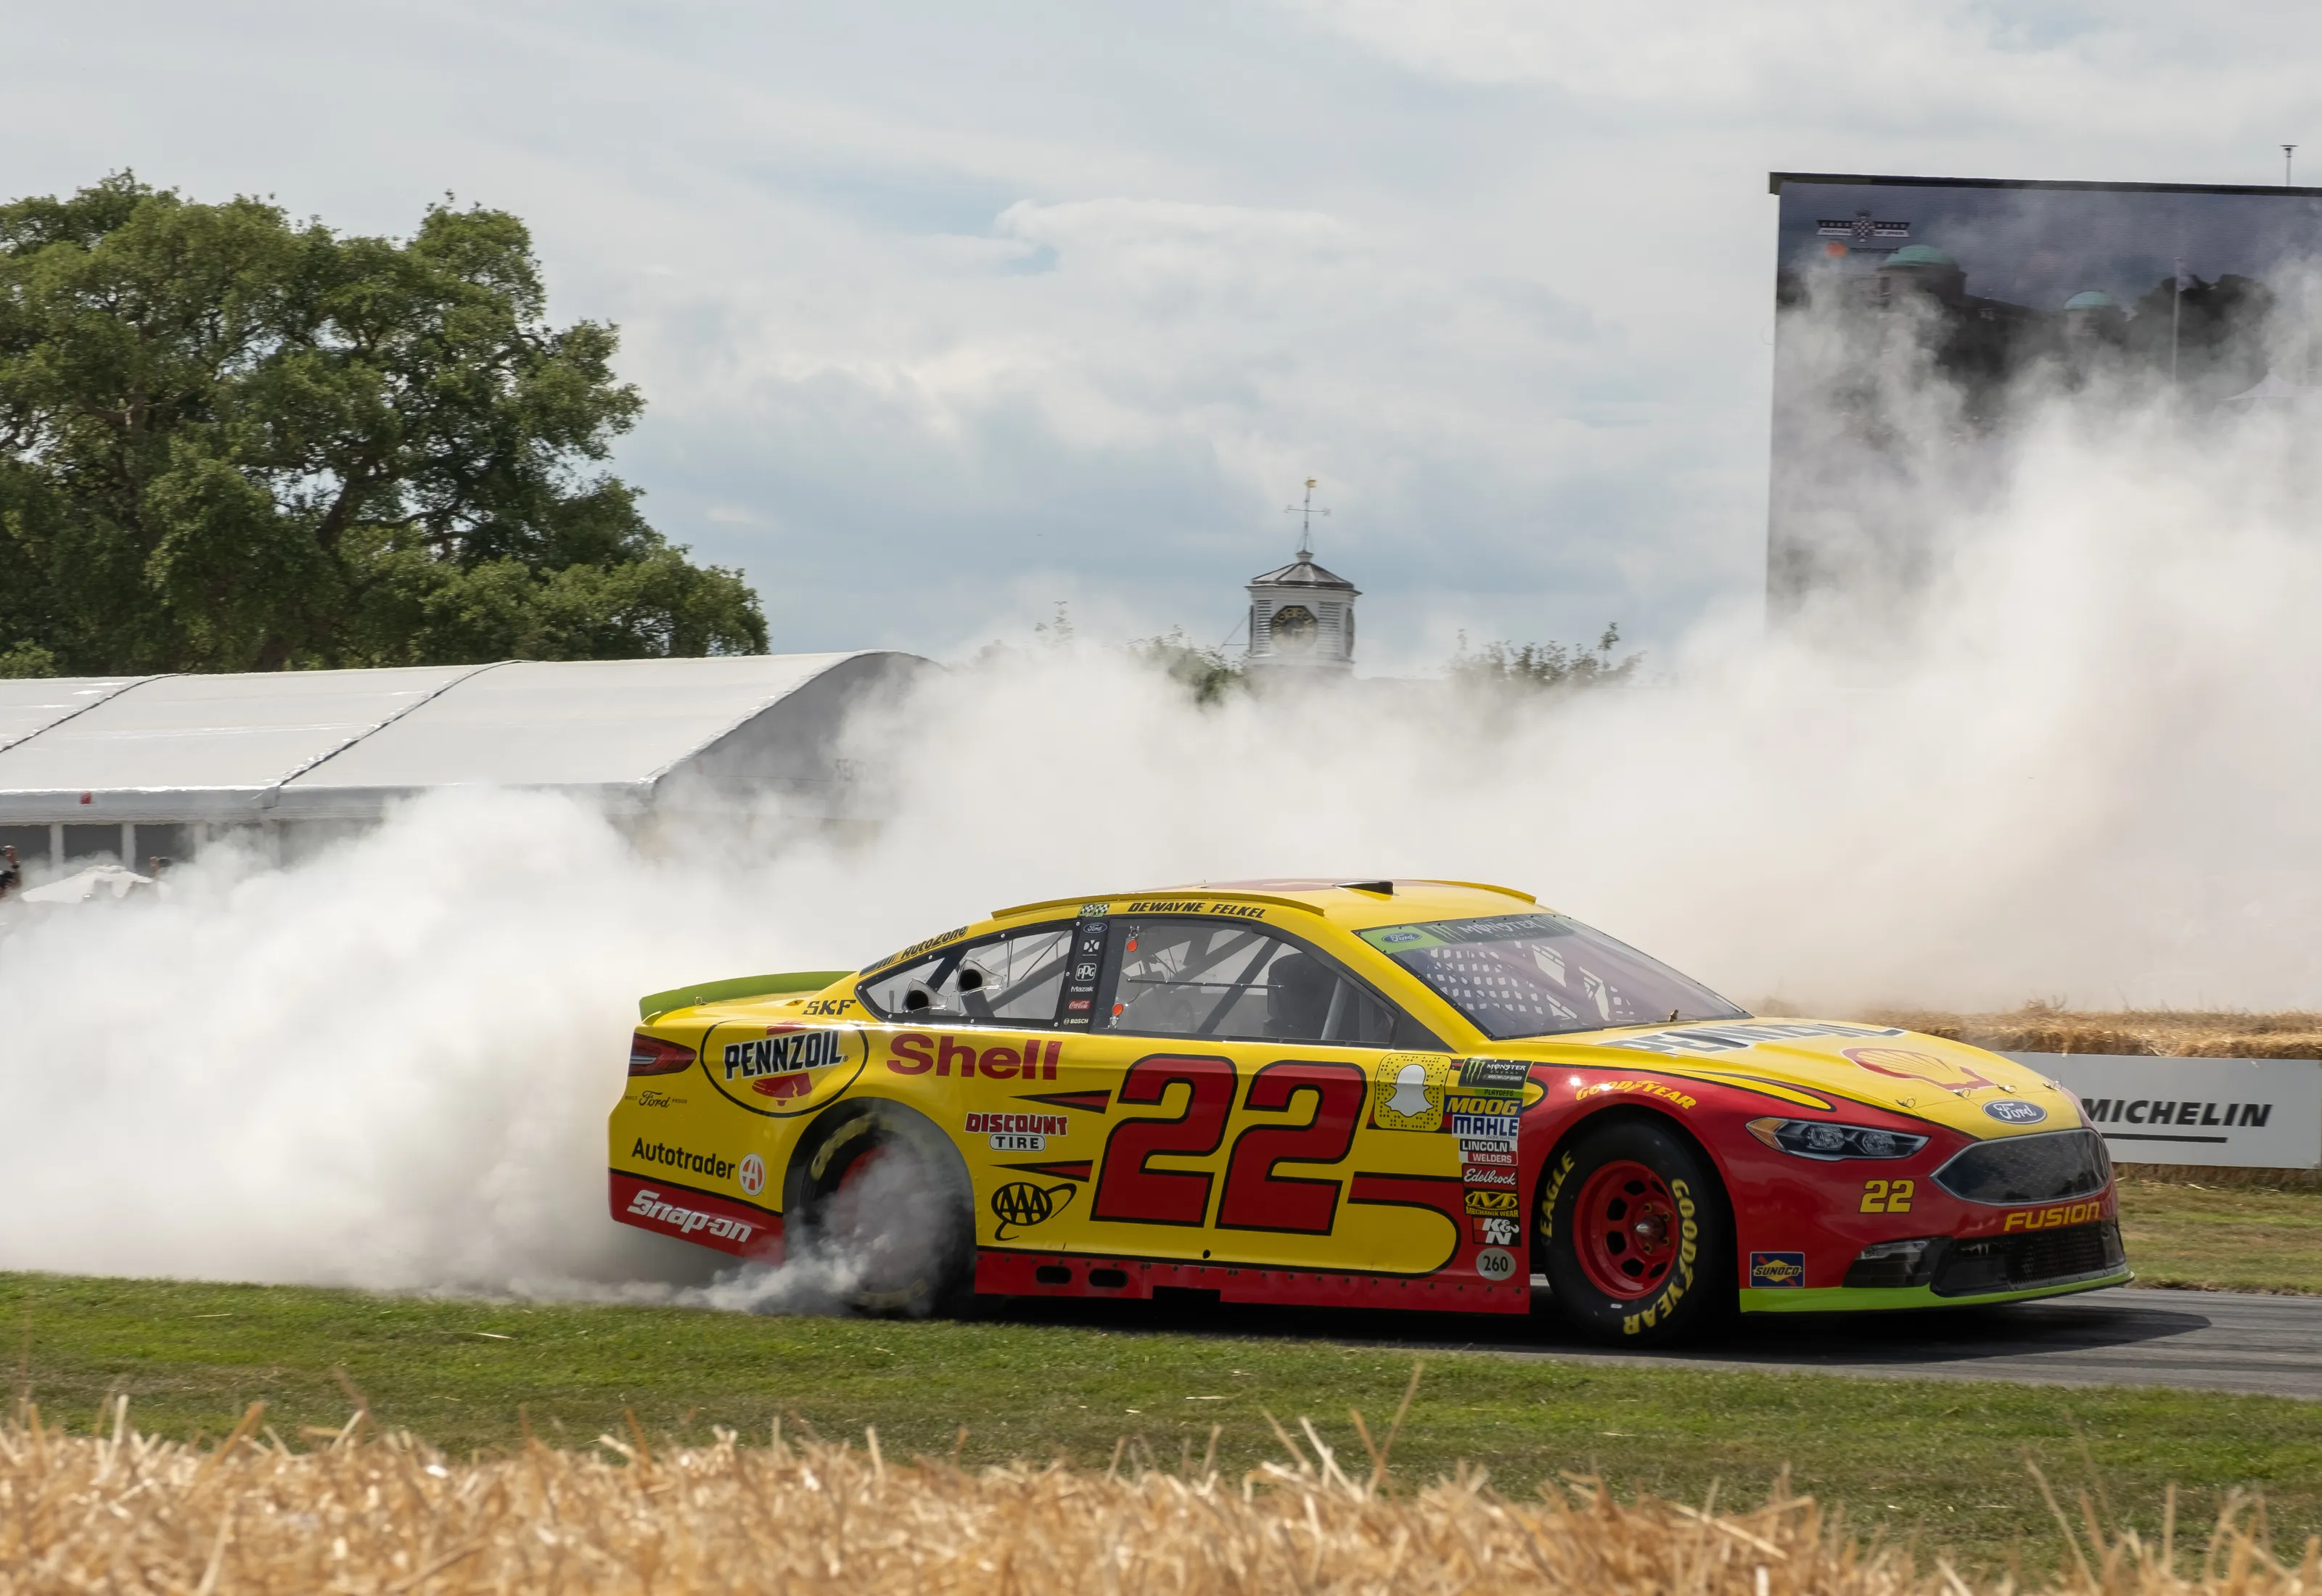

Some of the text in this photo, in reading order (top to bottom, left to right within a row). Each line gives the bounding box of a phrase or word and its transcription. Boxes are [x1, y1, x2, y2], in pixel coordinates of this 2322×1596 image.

[1127, 902, 1267, 918] DEWAYNE FELKEL
[901, 926, 969, 960] AutoZone
[802, 1000, 856, 1015] SKF
[723, 1031, 844, 1081] PENNZOIL
[886, 1033, 1063, 1080] Shell
[639, 1090, 670, 1108] Ford
[1446, 1098, 1520, 1116] MOOG
[1575, 1080, 1697, 1109] GOODYEAR
[965, 1113, 1067, 1135] DISCOUNT
[2080, 1098, 2273, 1127] MICHELIN
[1453, 1116, 1518, 1136] MAHLE
[996, 1137, 1039, 1149] TIRE
[1089, 1053, 1368, 1236] 22
[1462, 1140, 1507, 1152] LINCOLN
[631, 1137, 735, 1180] Autotrader
[1472, 1153, 1512, 1164] WELDERS
[1464, 1168, 1516, 1185] Edelbrock
[996, 1185, 1046, 1224] AAA
[1541, 1150, 1575, 1238] EAGLE
[1859, 1180, 1914, 1213] 22
[627, 1190, 752, 1243] Snap-on
[1466, 1206, 1499, 1217] MECHANIX
[2003, 1201, 2101, 1231] FUSION
[1483, 1256, 1509, 1272] 260
[1623, 1179, 1698, 1334] GOODYEAR
[1755, 1267, 1800, 1275] SUNOCO
